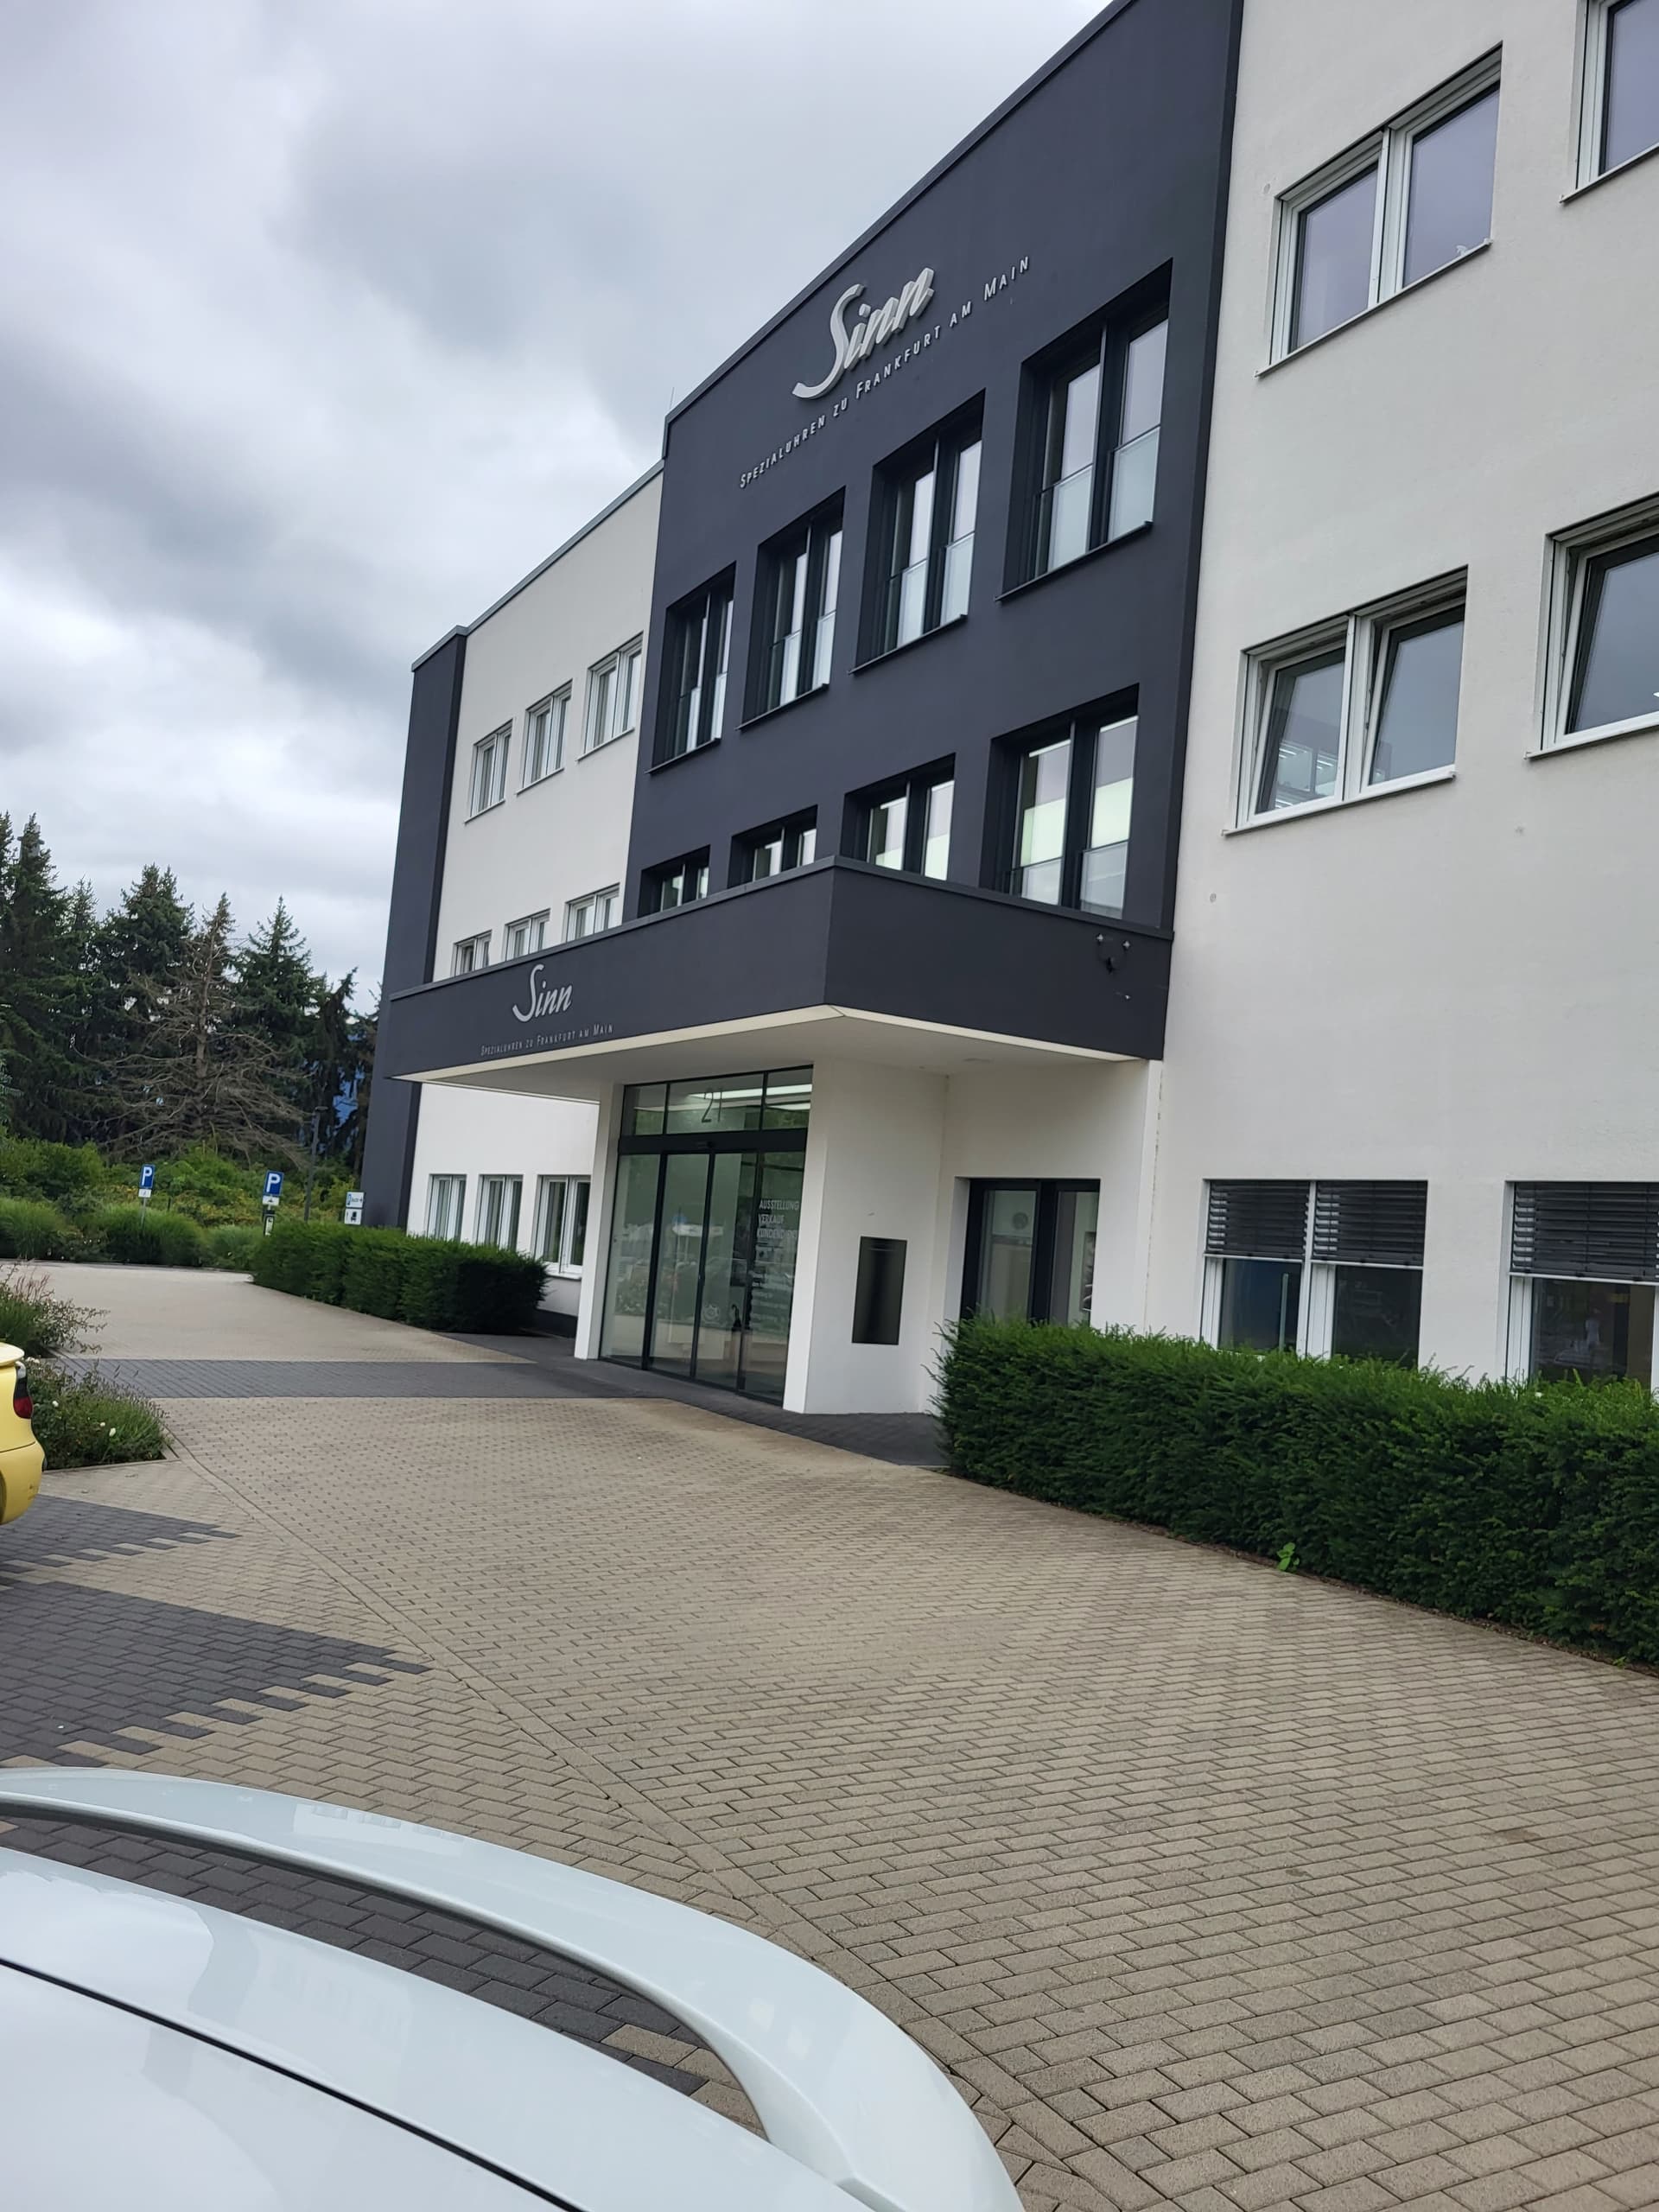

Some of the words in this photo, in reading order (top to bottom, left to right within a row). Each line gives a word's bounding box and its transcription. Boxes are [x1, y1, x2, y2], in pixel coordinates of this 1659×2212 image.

[791, 267, 934, 400] Sinn
[740, 414, 826, 489] SPEZIALUHREN
[832, 397, 849, 417] ZU
[855, 325, 941, 400] FRANKFURT
[950, 301, 972, 327] AM
[983, 256, 1028, 302] MAIN
[512, 963, 574, 1022] Sinn
[593, 1024, 613, 1036] MAIN
[142, 1166, 153, 1186] P
[266, 1173, 281, 1193] P
